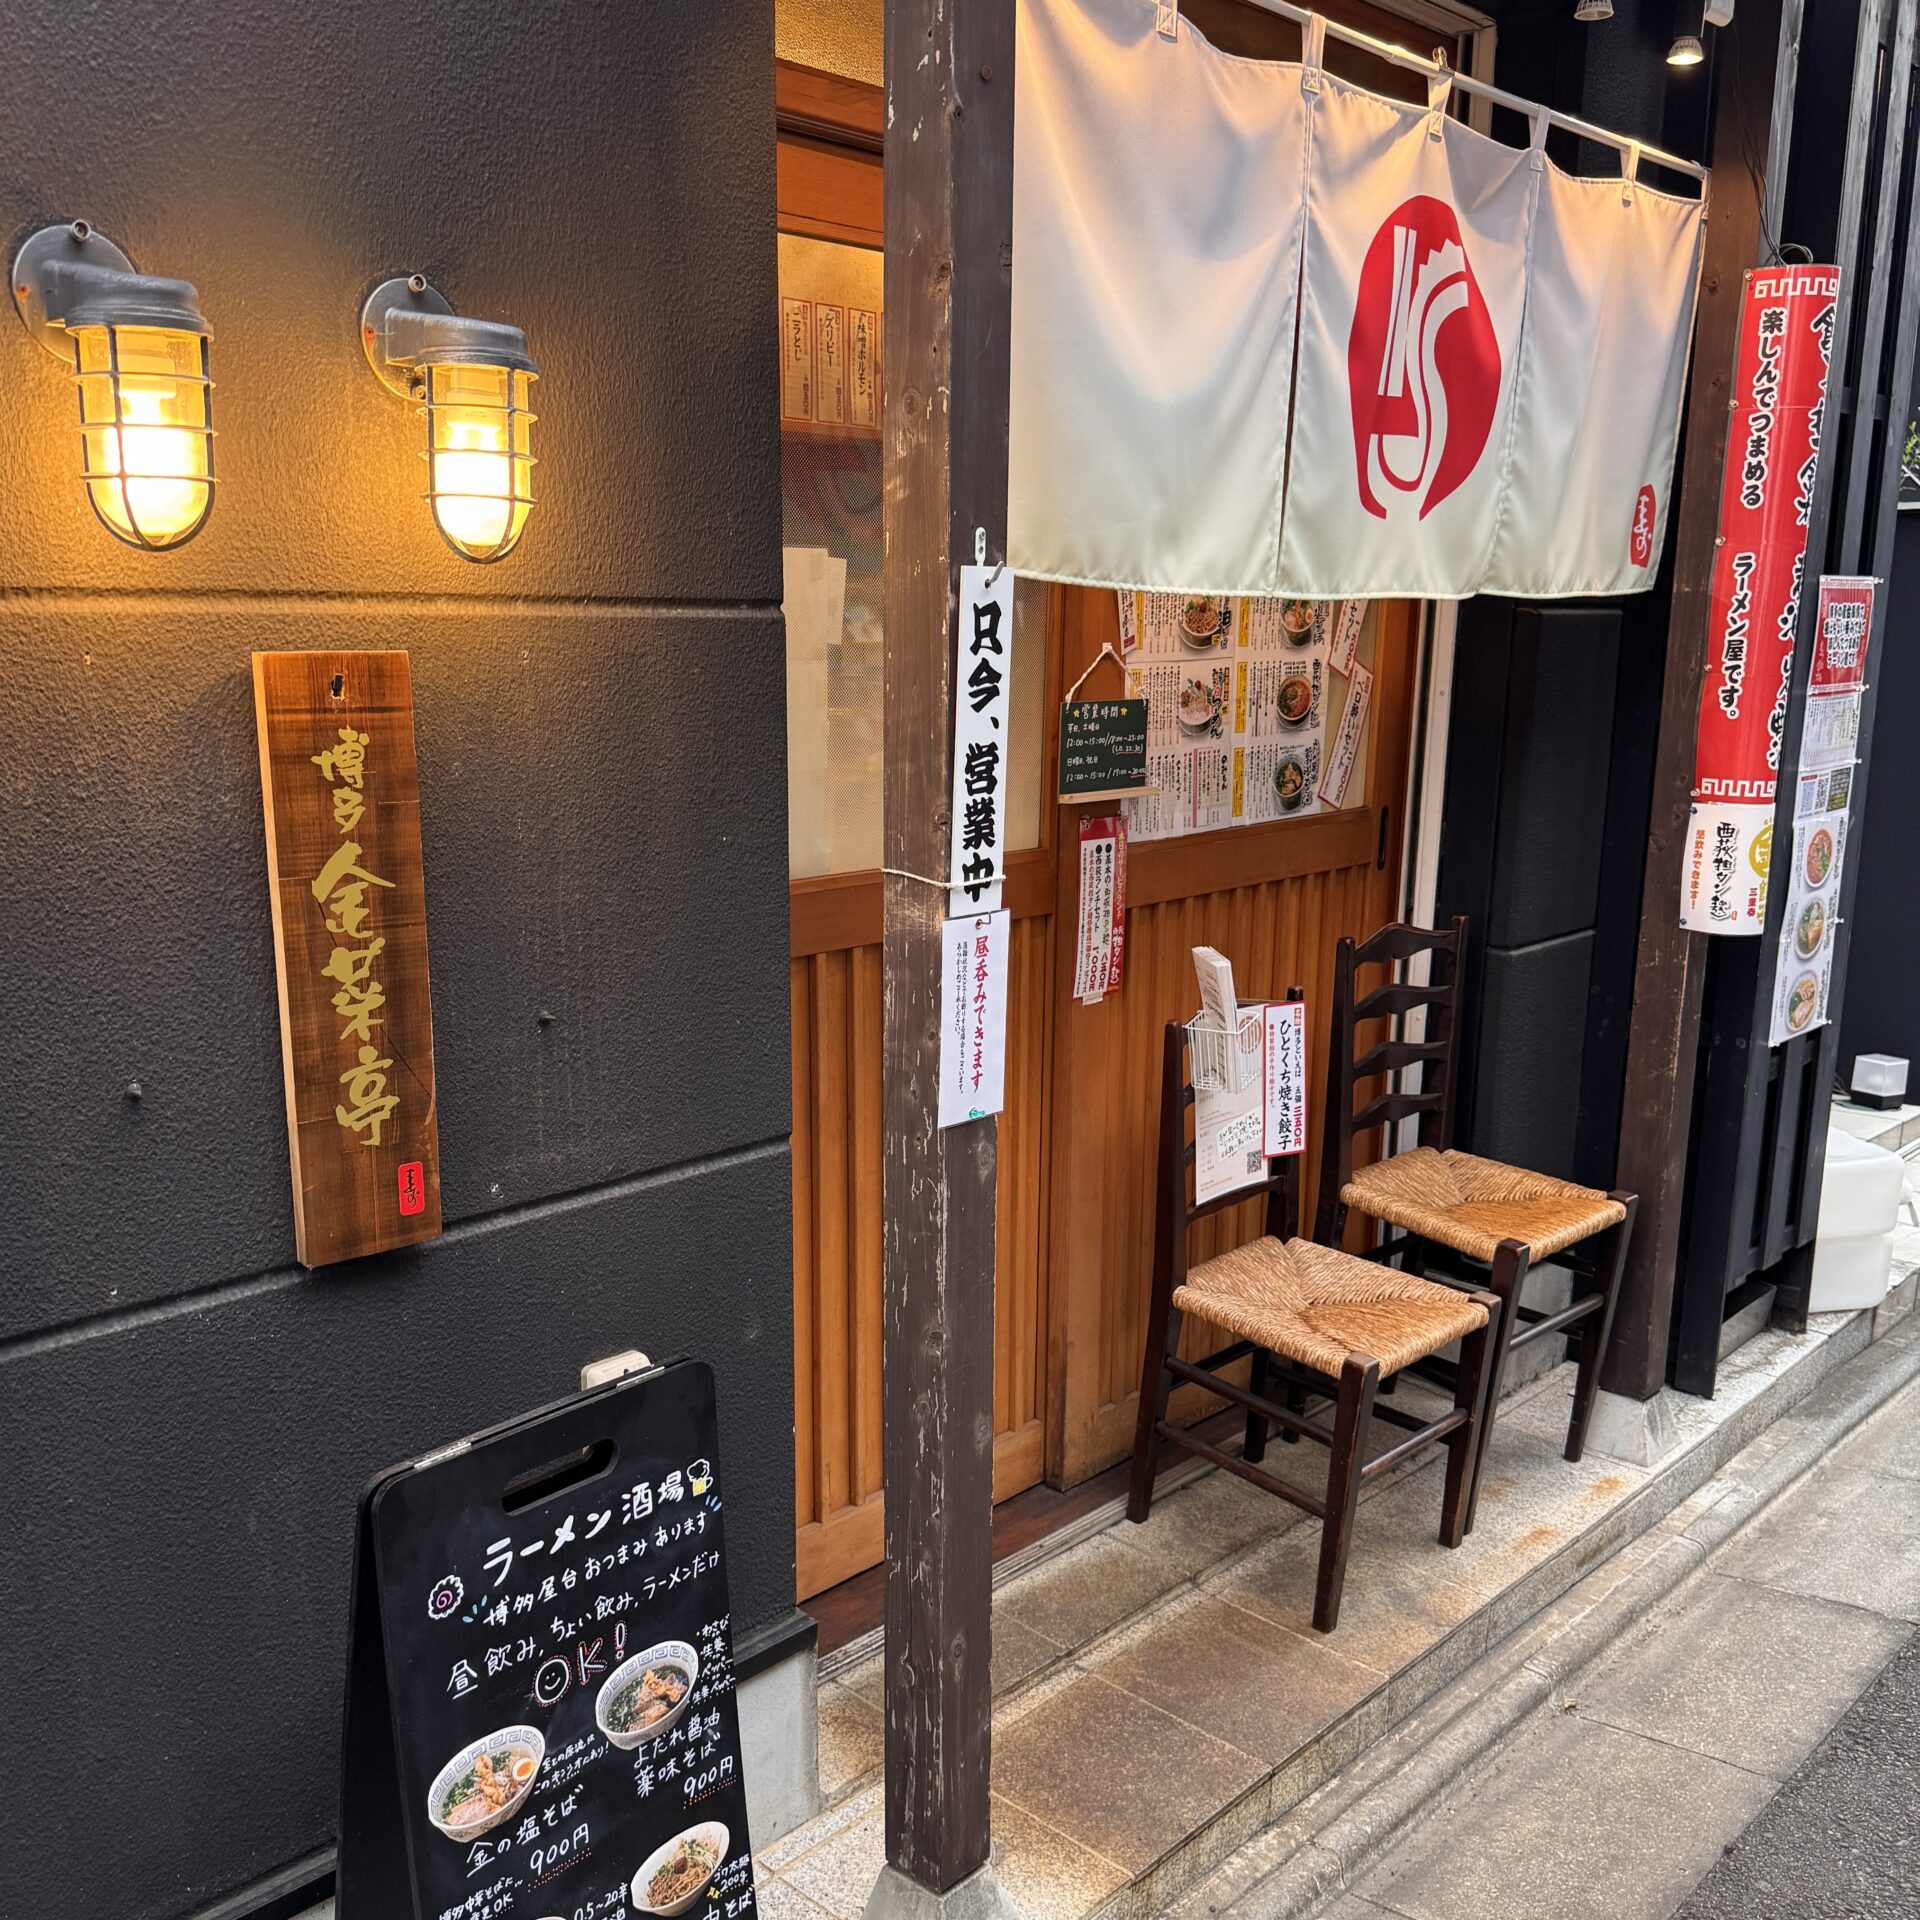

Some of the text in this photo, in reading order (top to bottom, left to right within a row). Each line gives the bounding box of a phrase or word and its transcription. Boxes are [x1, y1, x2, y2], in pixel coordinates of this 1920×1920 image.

[1741, 307, 1787, 509] 楽しんでつまめる
[1720, 553, 1755, 720] ラーメン屋です。
[962, 599, 1003, 902] 只今、営業中
[1082, 703, 1119, 720] 営業時間
[970, 935, 989, 1093] 昼呑みできます
[1278, 1020, 1292, 1150] ひとくち焼き餃子
[634, 1707, 720, 1769] よだれ醤油
[684, 1755, 733, 1798] 900円
[466, 1783, 584, 1878] 金の塩そば
[530, 1822, 590, 1875] 900円
